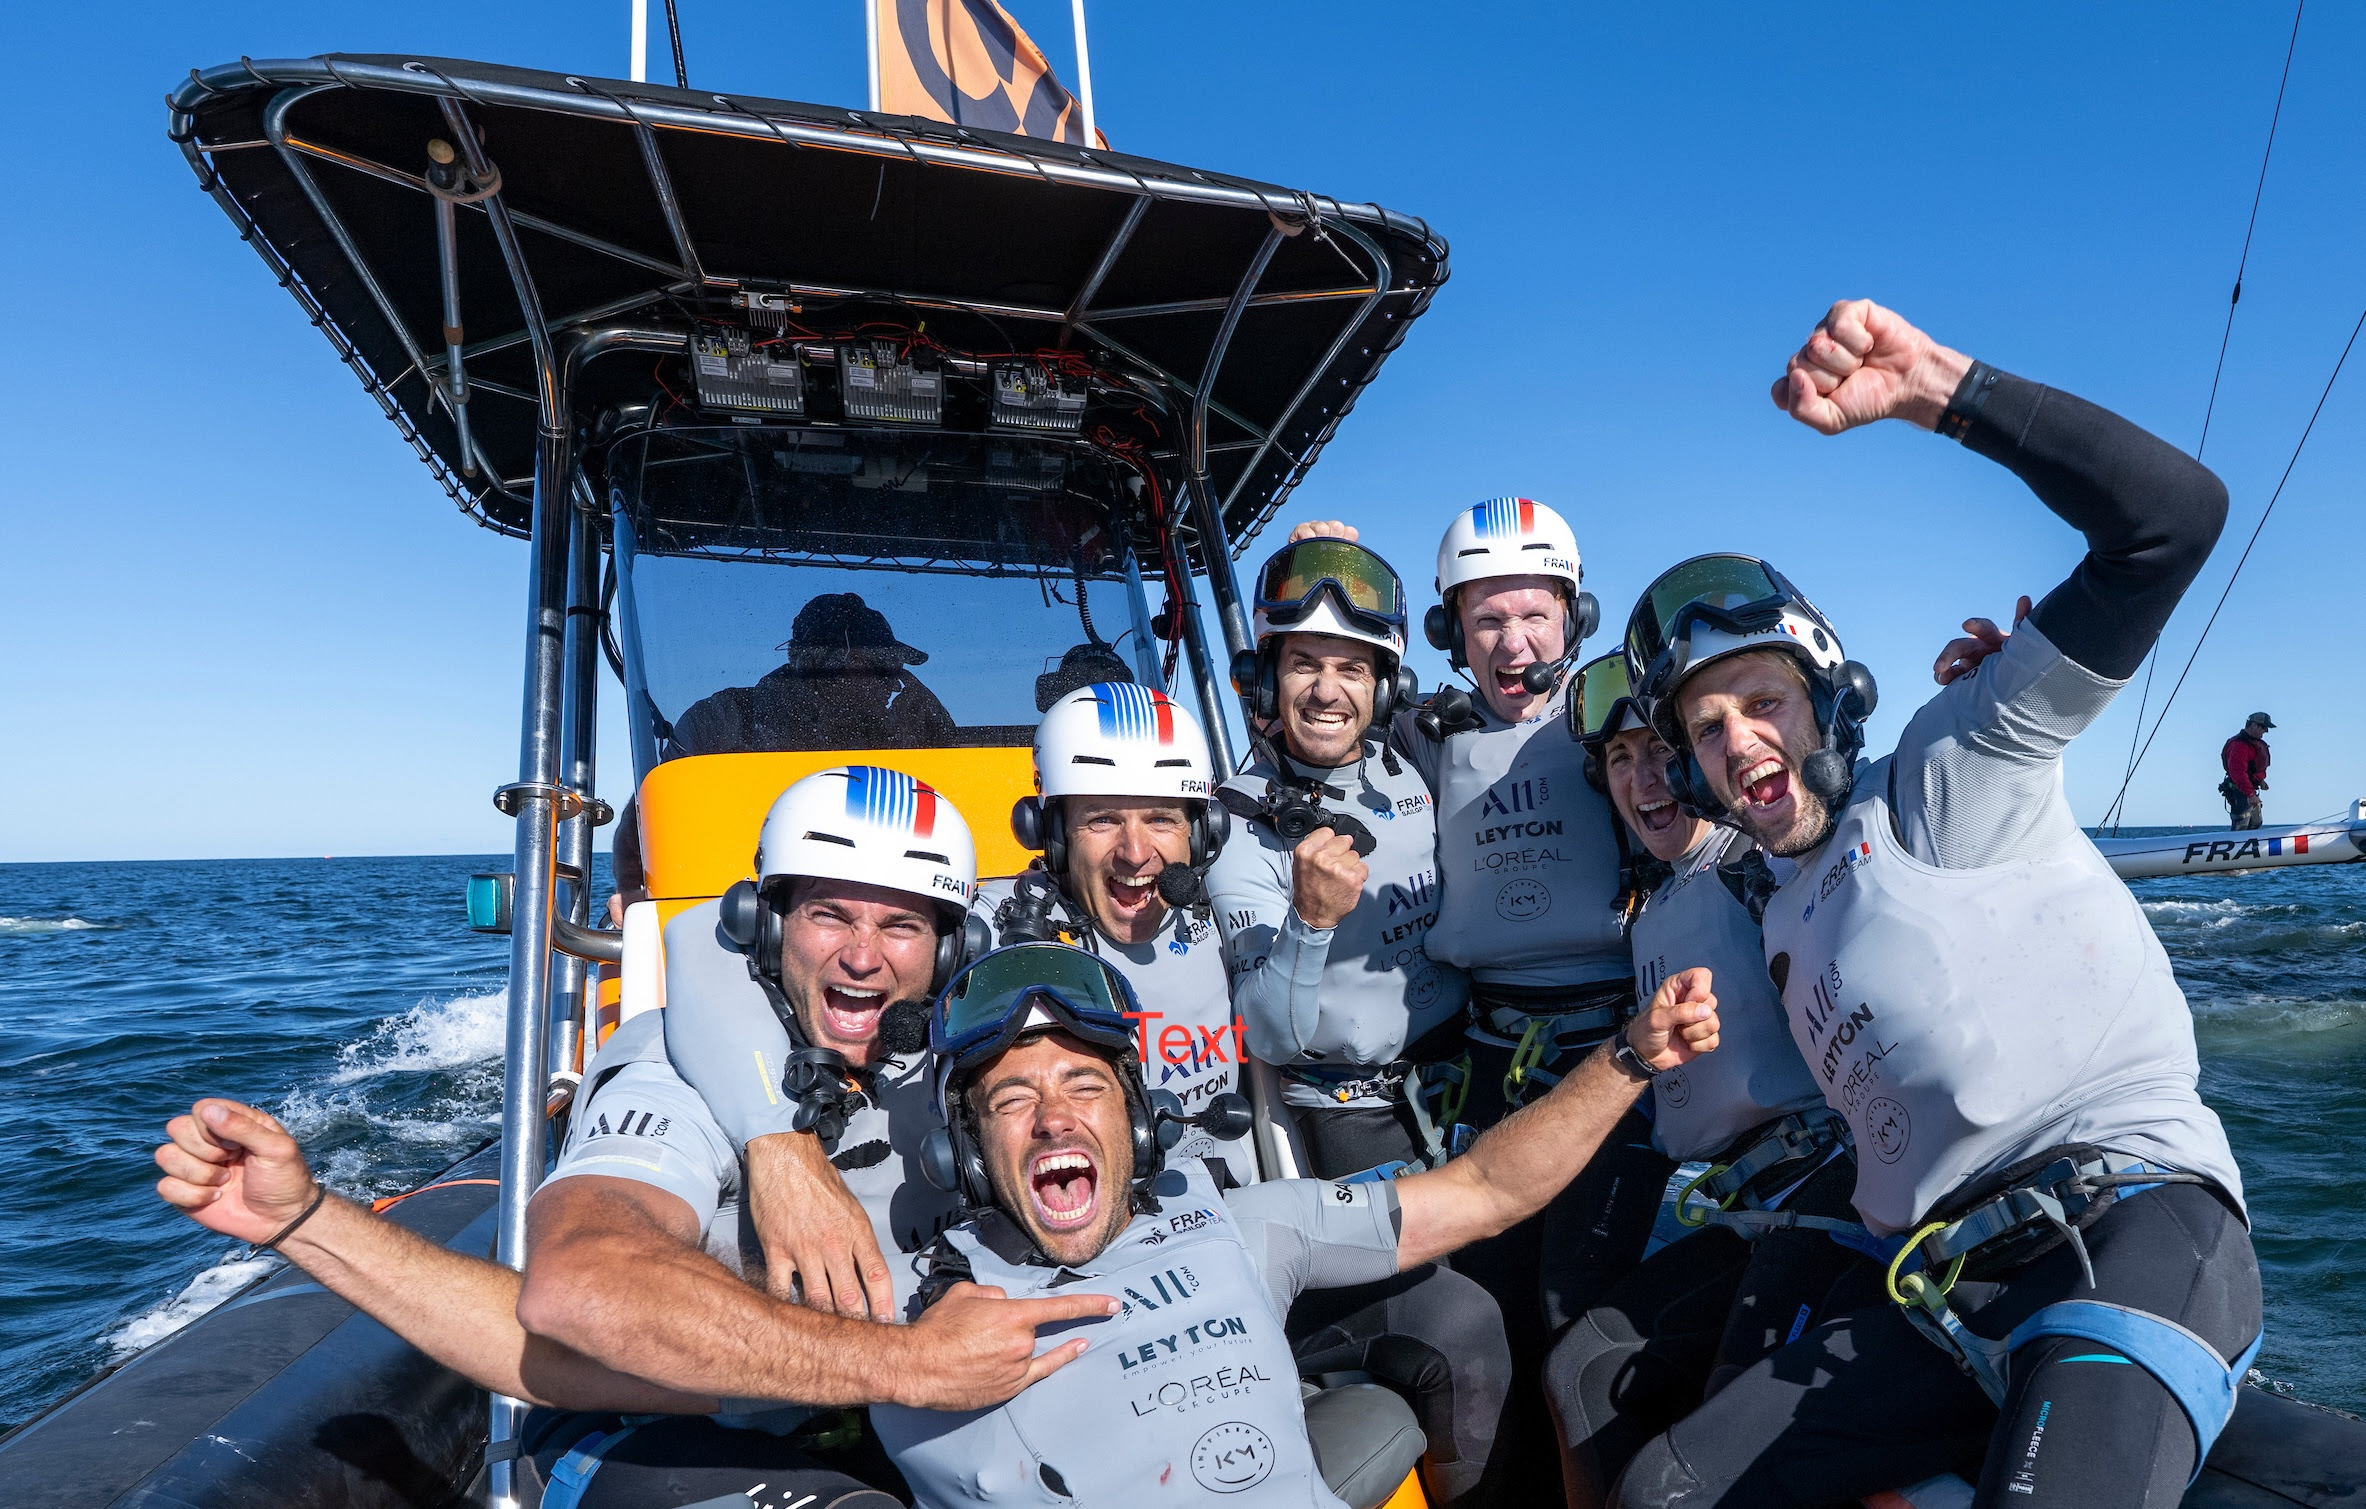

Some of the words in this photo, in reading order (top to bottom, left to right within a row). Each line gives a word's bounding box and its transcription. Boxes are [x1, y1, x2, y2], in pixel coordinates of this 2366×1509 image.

[1543, 557, 1566, 569] FRA
[1181, 779, 1204, 793] FRA
[1396, 795, 1423, 812] FRA
[1480, 779, 1537, 821] All
[1475, 820, 1563, 846] LEYTON
[1474, 848, 1573, 872] L'ORÉAL
[2182, 838, 2261, 864] FRA
[1494, 863, 1548, 875] GROUPE
[1820, 872, 1846, 903] SAILGP
[1847, 855, 1872, 876] TEAM
[1821, 855, 1849, 895] FRA
[932, 874, 960, 894] FRA
[1821, 1002, 1875, 1085] LEYTON
[1177, 1070, 1229, 1107] YTON
[1841, 1040, 1899, 1116] L'ORÉAL
[1169, 1210, 1207, 1232] FRA
[1176, 1221, 1207, 1234] SAILGP
[1180, 1265, 1200, 1292] .COM
[1117, 1317, 1248, 1371] LEYTON
[1123, 1355, 1183, 1380] Empower
[1190, 1342, 1218, 1357] your
[1131, 1364, 1271, 1417] L'ORÉAL
[1177, 1386, 1251, 1413] GROUPE
[2026, 1400, 2052, 1459] MICROFLEECE
[1198, 1427, 1250, 1469] INSPIRED
[1257, 1437, 1268, 1451] BY
